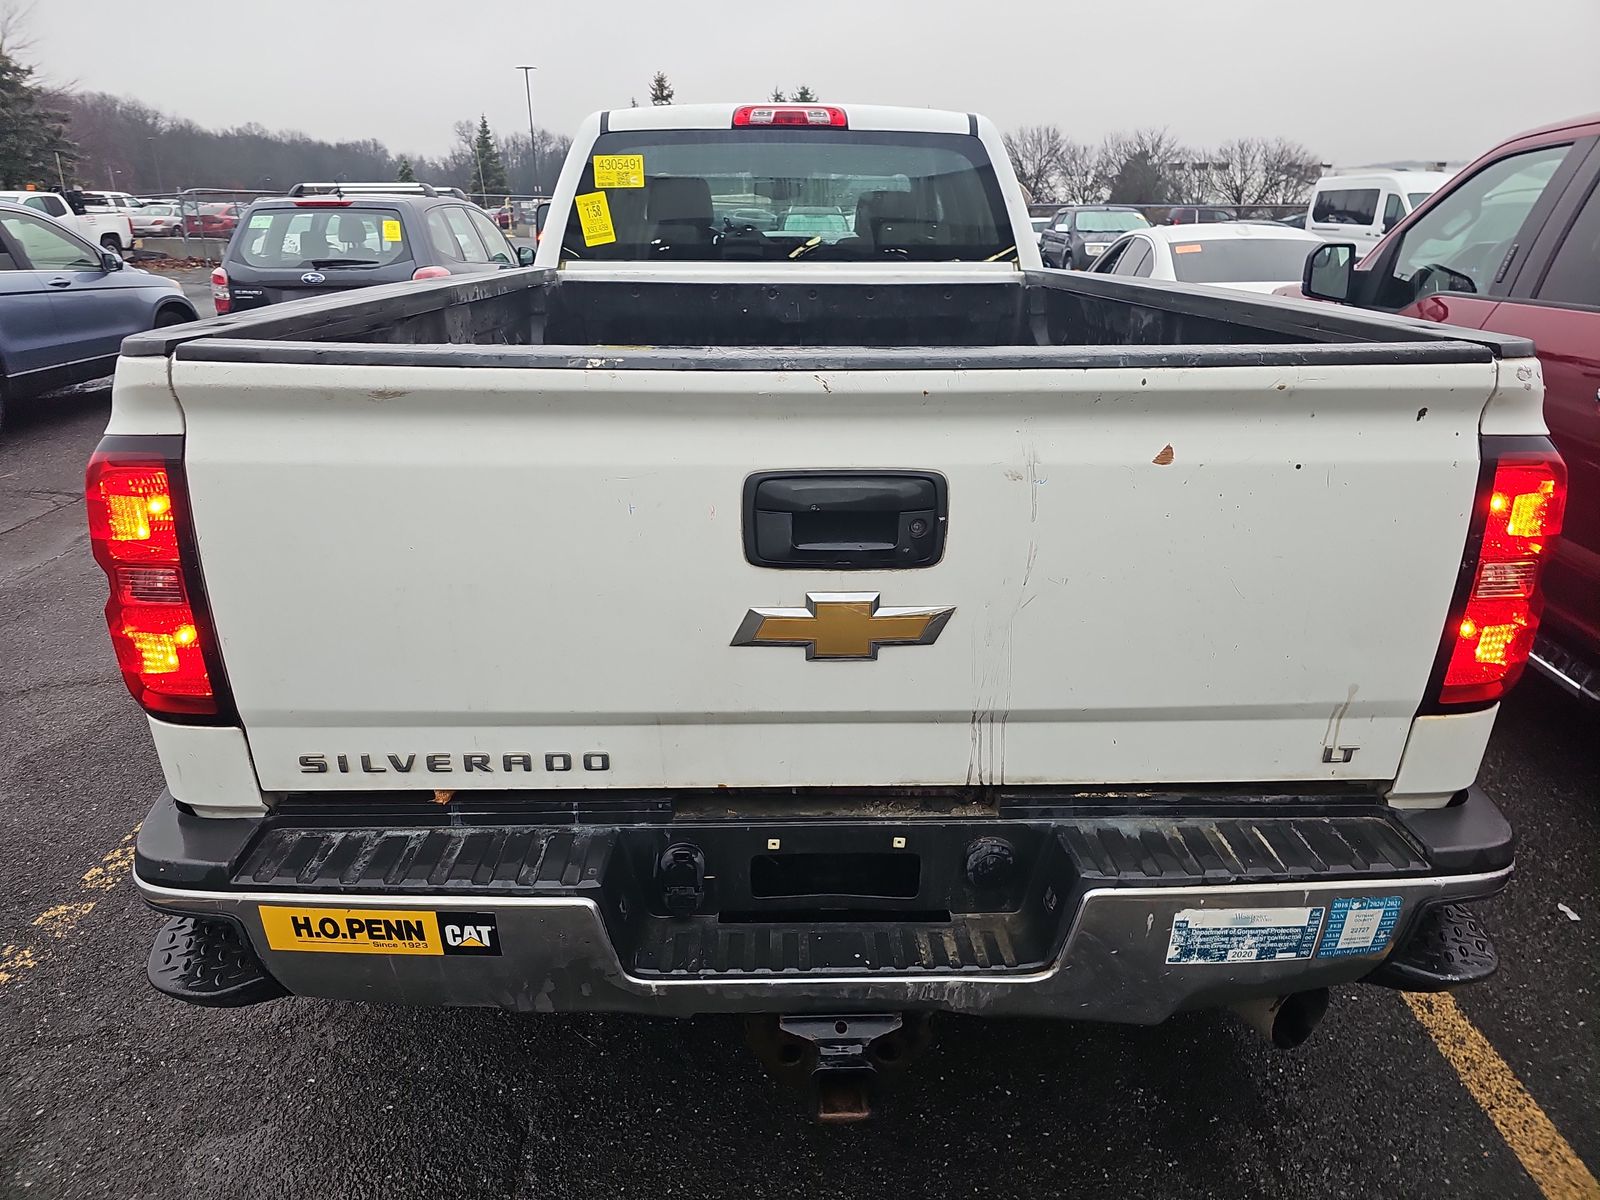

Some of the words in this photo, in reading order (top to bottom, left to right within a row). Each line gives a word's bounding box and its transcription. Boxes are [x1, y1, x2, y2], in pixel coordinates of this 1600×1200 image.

[599, 158, 641, 170] 4305491
[586, 204, 602, 218] 1:58
[1322, 744, 1361, 763] LT
[299, 752, 611, 773] SILVERADO
[290, 915, 427, 942] H.O.PENN
[444, 924, 493, 947] CAT
[1191, 928, 1228, 936] Department
[372, 941, 399, 949] Since
[402, 941, 429, 949] 1923
